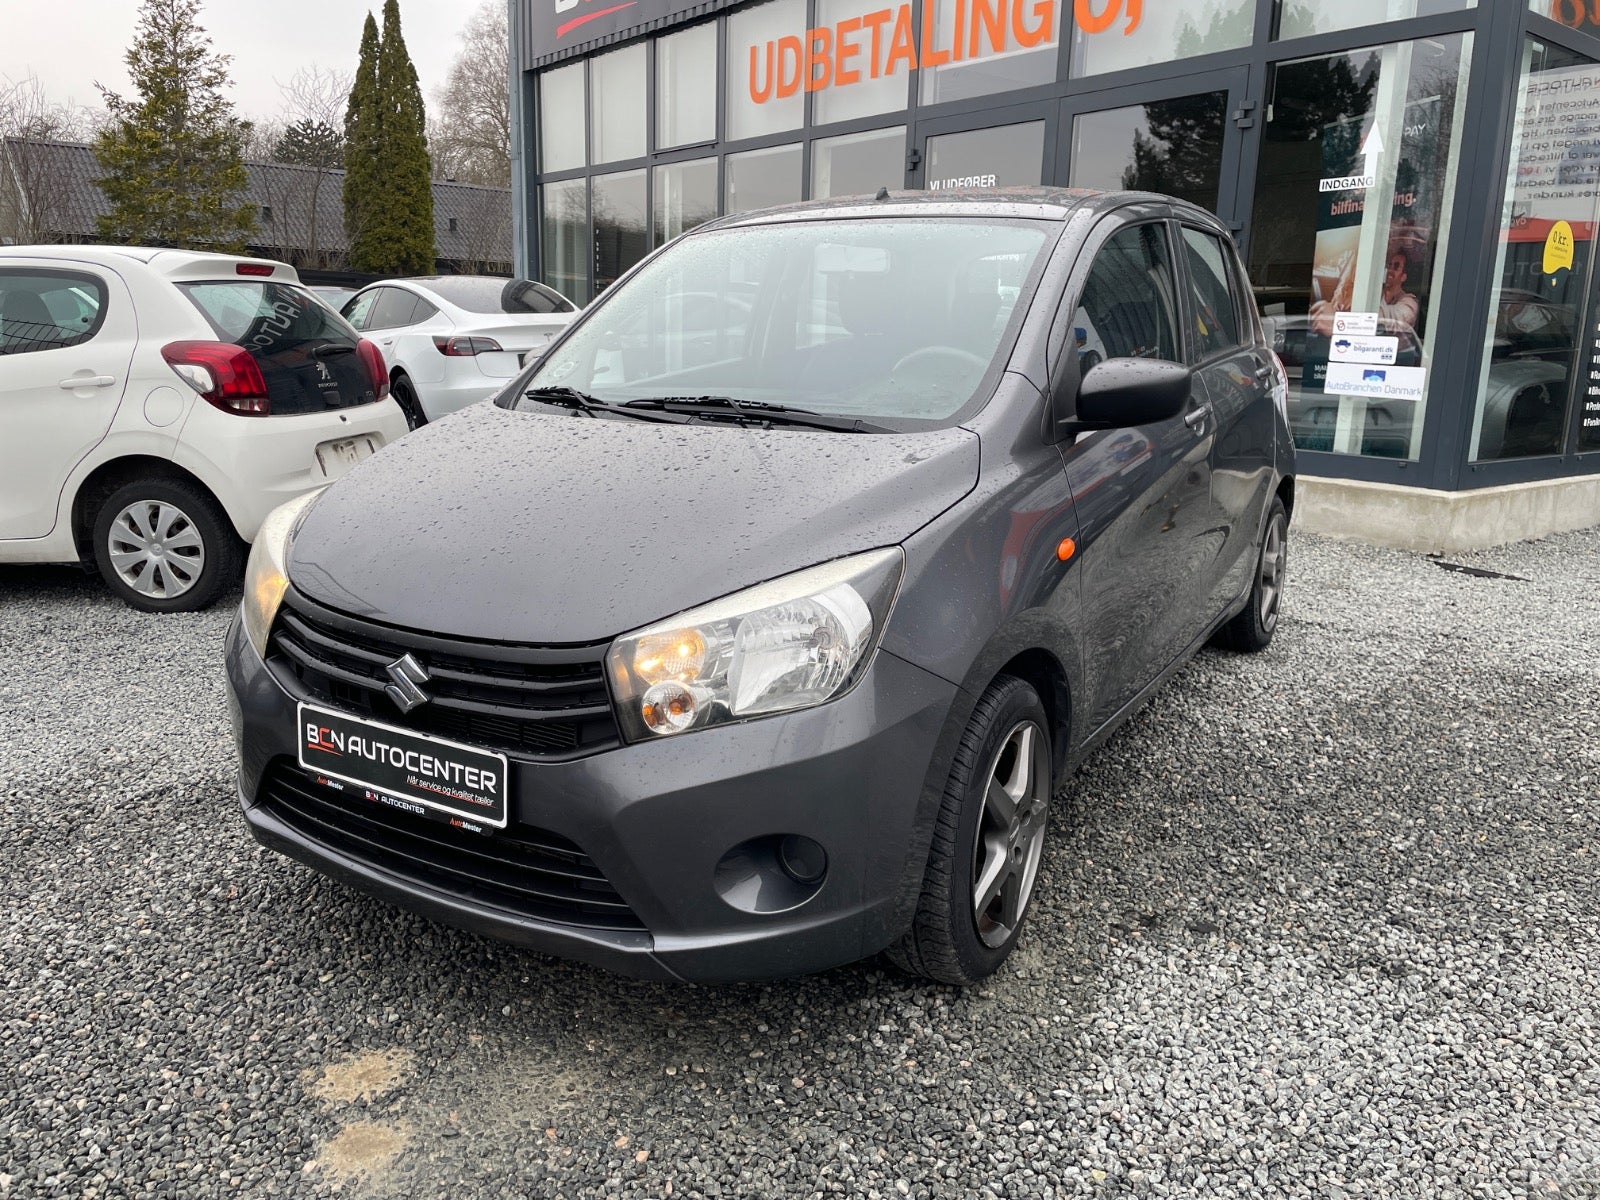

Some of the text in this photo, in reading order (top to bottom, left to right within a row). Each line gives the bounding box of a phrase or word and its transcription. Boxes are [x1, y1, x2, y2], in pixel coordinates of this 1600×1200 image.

[749, 0, 1055, 105] UDBETALING
[1321, 176, 1374, 190] INDGANG
[1353, 344, 1393, 354] bilgaranti.dk
[1326, 380, 1422, 395] AutoBranchen Danmark
[306, 722, 497, 794] BCN AUTOCENTER
[406, 774, 418, 785] Når
[418, 779, 441, 791] service
[442, 786, 451, 796] og
[451, 786, 475, 802] kvalitet
[381, 796, 425, 815] AUTOCENTER
[449, 817, 482, 833] AutoMester
